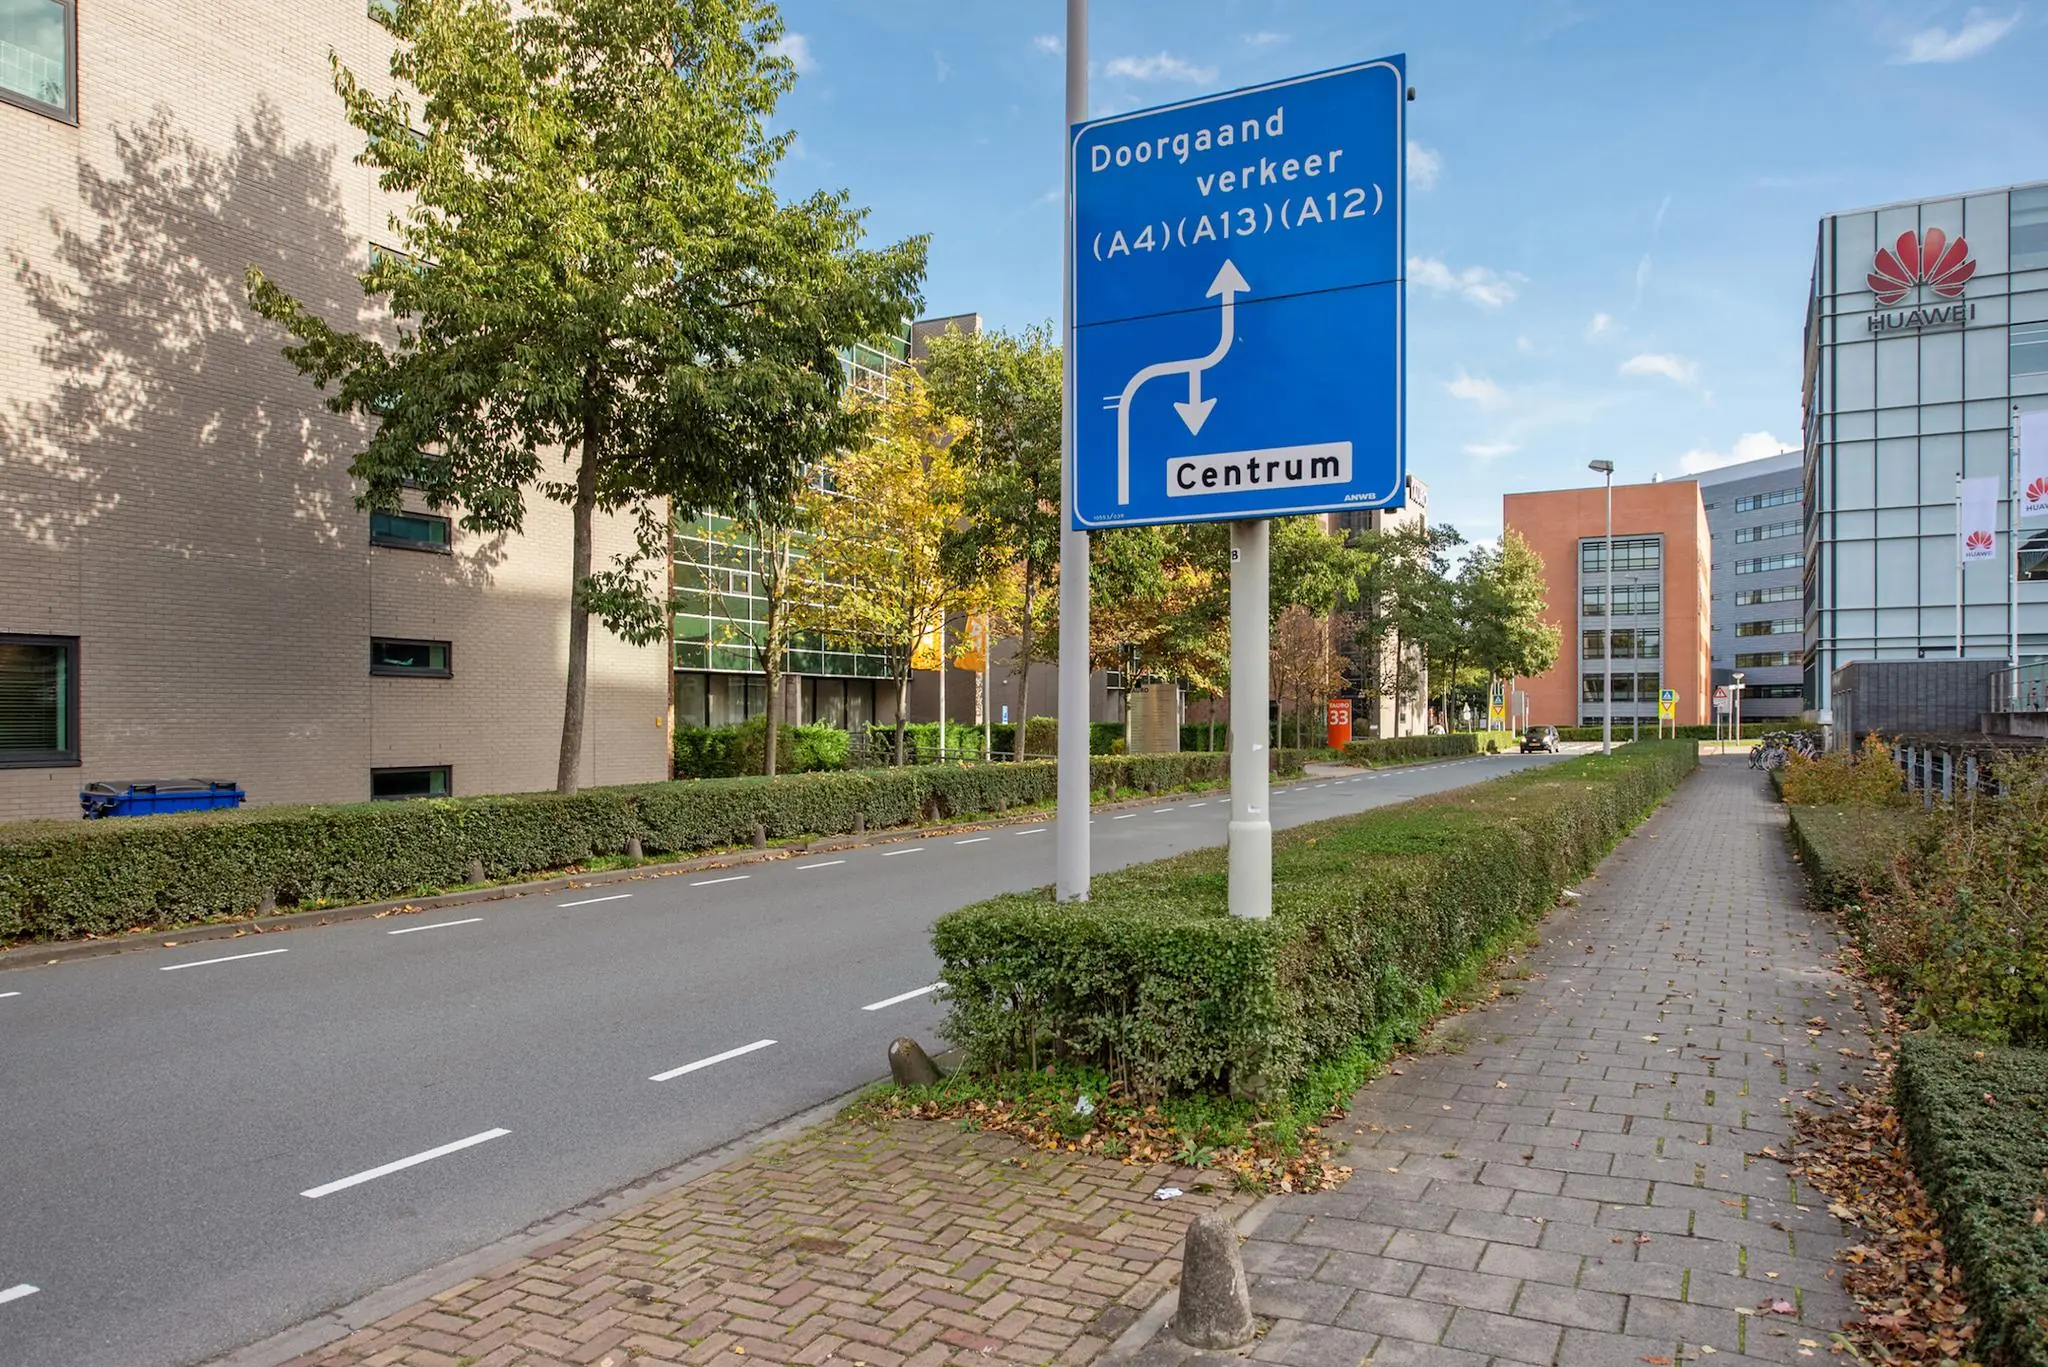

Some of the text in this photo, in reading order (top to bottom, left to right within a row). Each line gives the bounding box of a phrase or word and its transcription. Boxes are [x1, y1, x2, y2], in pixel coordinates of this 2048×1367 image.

[1092, 106, 1284, 173] Doorgaand
[1197, 149, 1343, 197] verkeer
[1867, 303, 1976, 332] HUAWEI
[1177, 456, 1339, 490] Centrum
[1344, 492, 1376, 502] ANWB
[1330, 710, 1348, 725] 33
